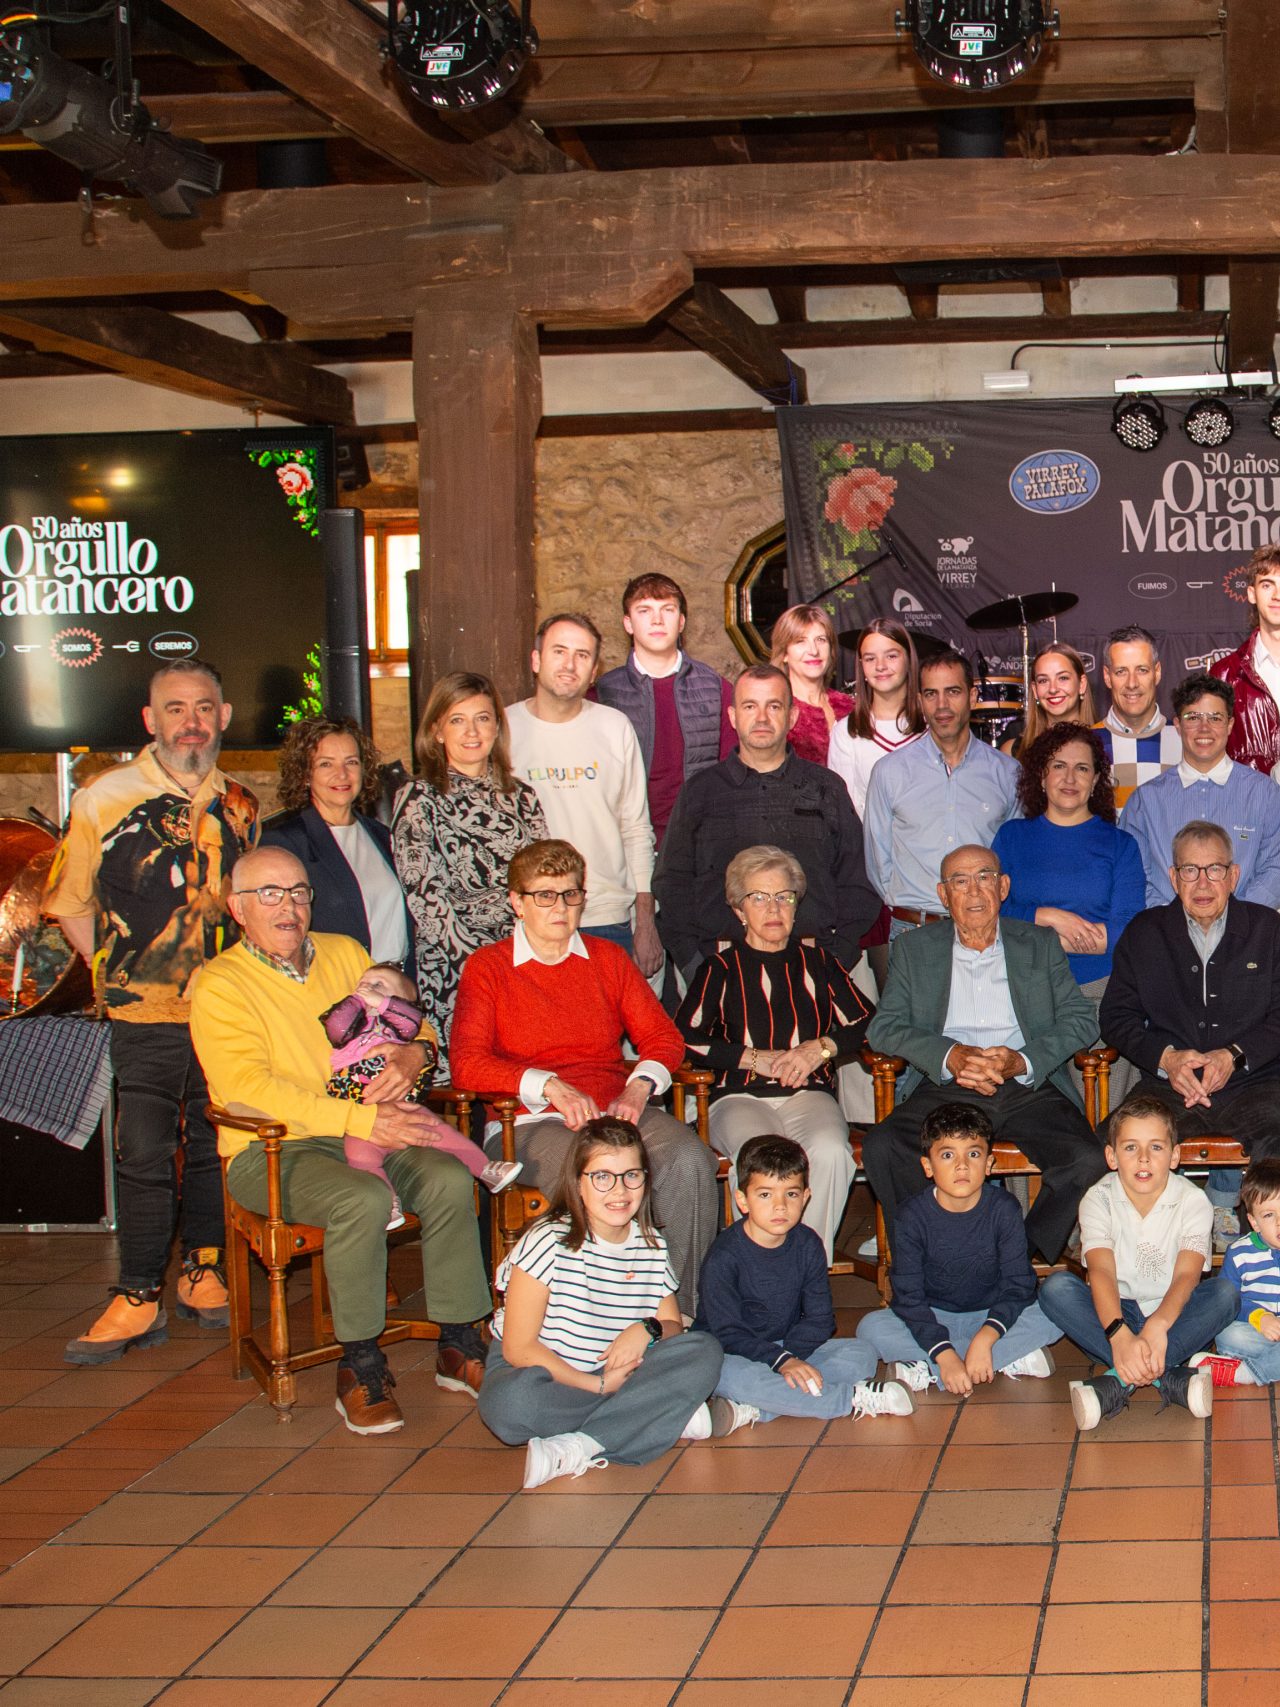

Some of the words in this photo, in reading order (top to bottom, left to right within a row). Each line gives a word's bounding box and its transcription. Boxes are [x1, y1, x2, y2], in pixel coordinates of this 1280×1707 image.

[961, 42, 981, 50] JVF
[1203, 452, 1230, 475] 50
[1233, 453, 1279, 475] años
[1025, 463, 1079, 484] VIRREY
[1023, 477, 1088, 500] PALAFOX
[32, 515, 59, 540] 50
[59, 516, 104, 539] años
[0, 521, 158, 588] Orgullo
[937, 557, 977, 565] JORNADAS
[937, 572, 977, 584] VIRREY
[1137, 581, 1168, 590] FUIMOS
[0, 575, 194, 617] atancero
[62, 643, 91, 652] SOMOS
[154, 642, 193, 650] SEREMOS
[547, 765, 597, 781] PULPO
